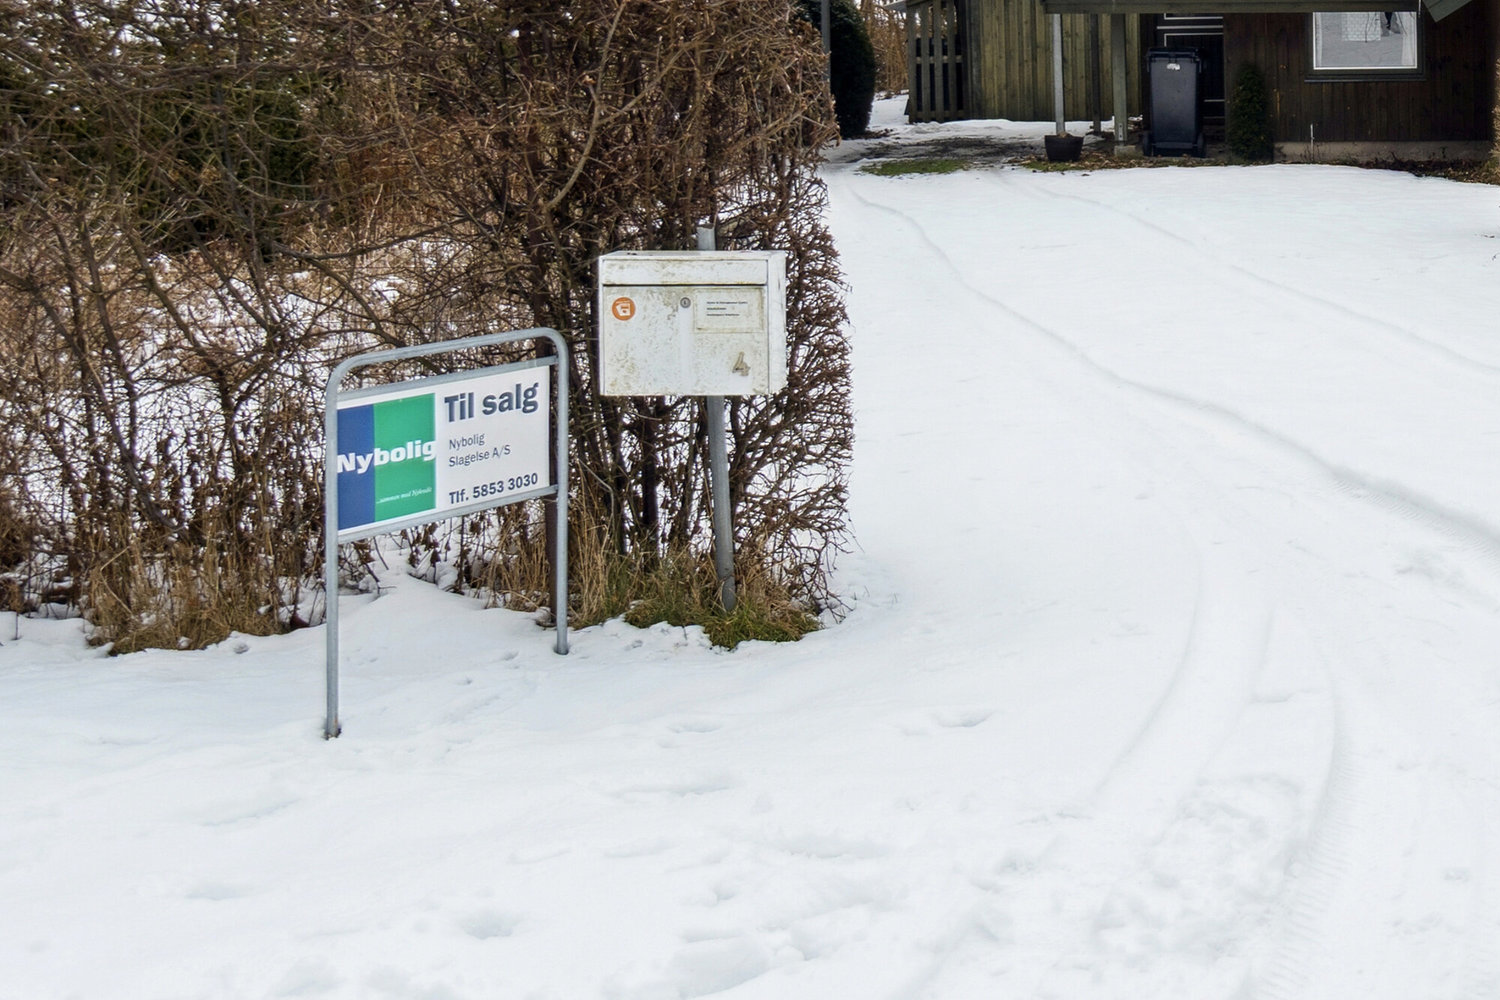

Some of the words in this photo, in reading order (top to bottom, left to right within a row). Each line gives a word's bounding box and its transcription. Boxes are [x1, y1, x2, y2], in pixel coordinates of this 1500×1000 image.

[443, 392, 474, 422] Til
[482, 382, 539, 414] salg
[336, 439, 437, 475] Nybolig
[448, 451, 490, 467] Slagelse
[492, 444, 511, 458] A/S
[449, 433, 485, 451] Nybolig
[448, 488, 469, 504] Tlf.
[473, 480, 504, 499] 5853
[508, 472, 538, 490] 3030
